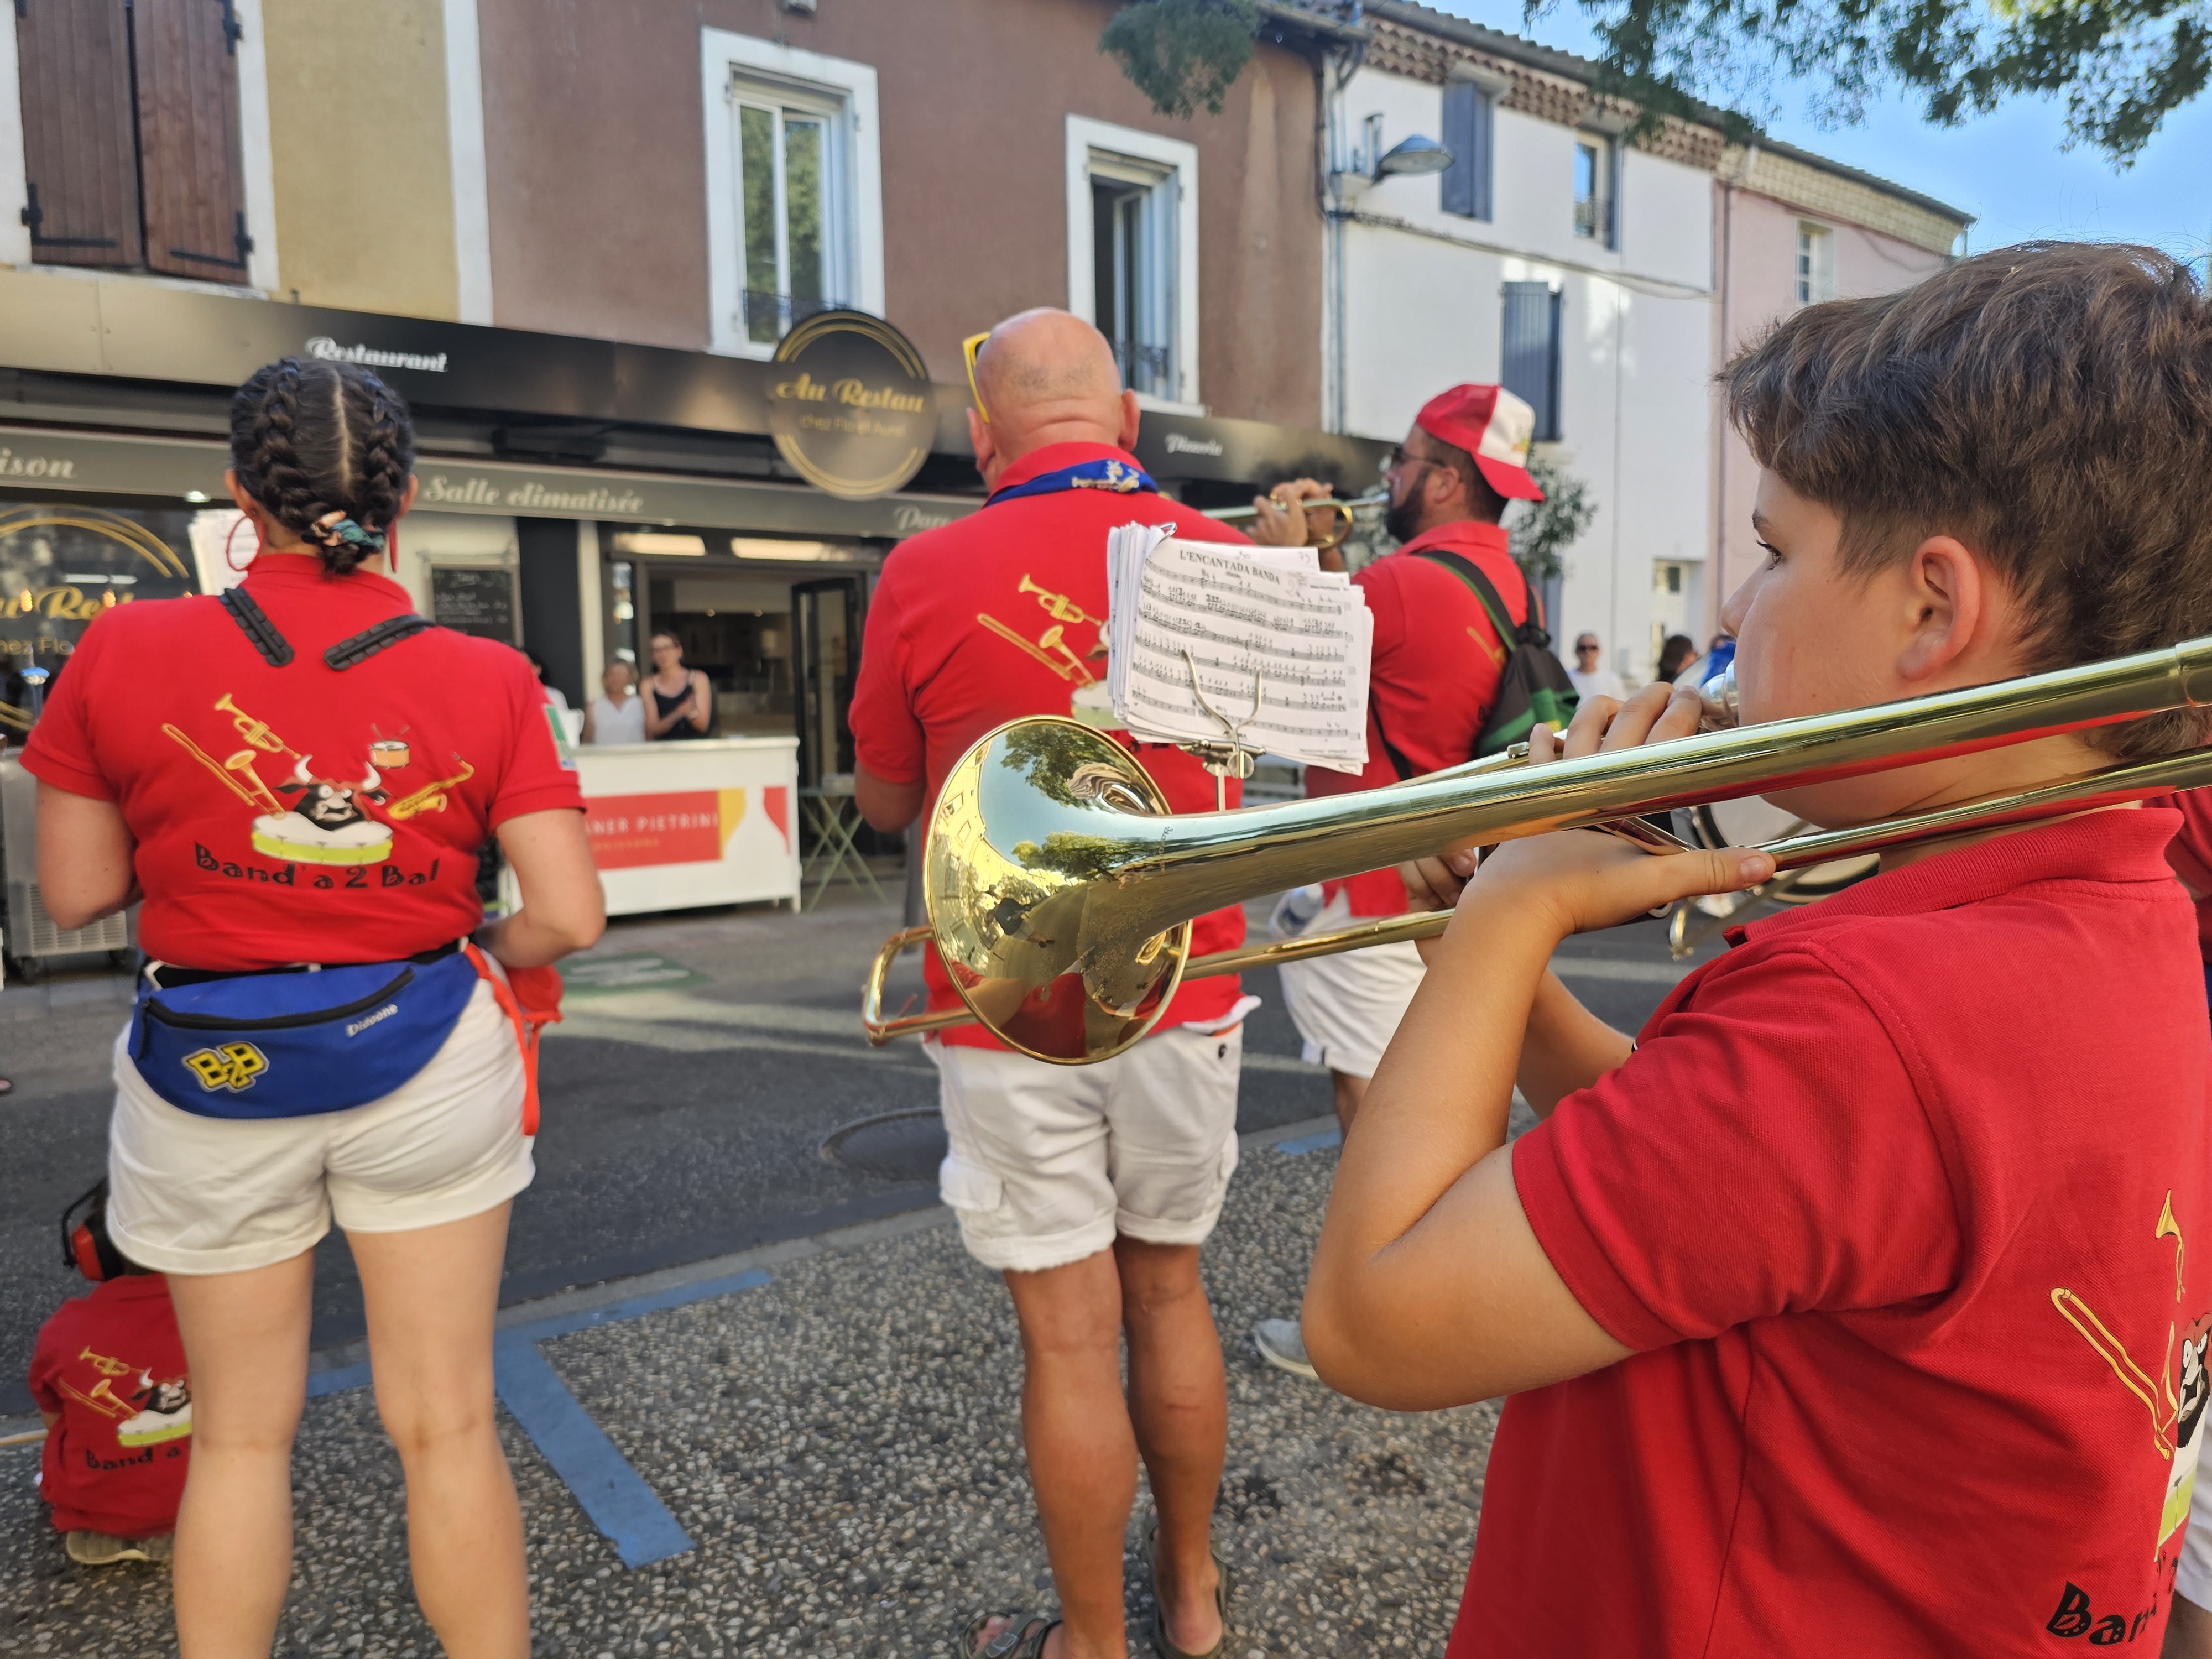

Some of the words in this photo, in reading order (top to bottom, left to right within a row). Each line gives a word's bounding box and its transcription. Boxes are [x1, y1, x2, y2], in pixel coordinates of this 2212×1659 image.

[305, 336, 448, 372] Restaurant
[775, 372, 826, 402] Au
[832, 378, 925, 413] Restau
[422, 473, 500, 505] Salle
[1180, 550, 1250, 575] L'ENCANTADA
[1252, 566, 1280, 585] BANDA
[345, 865, 369, 888] 2
[382, 857, 439, 888] Bal
